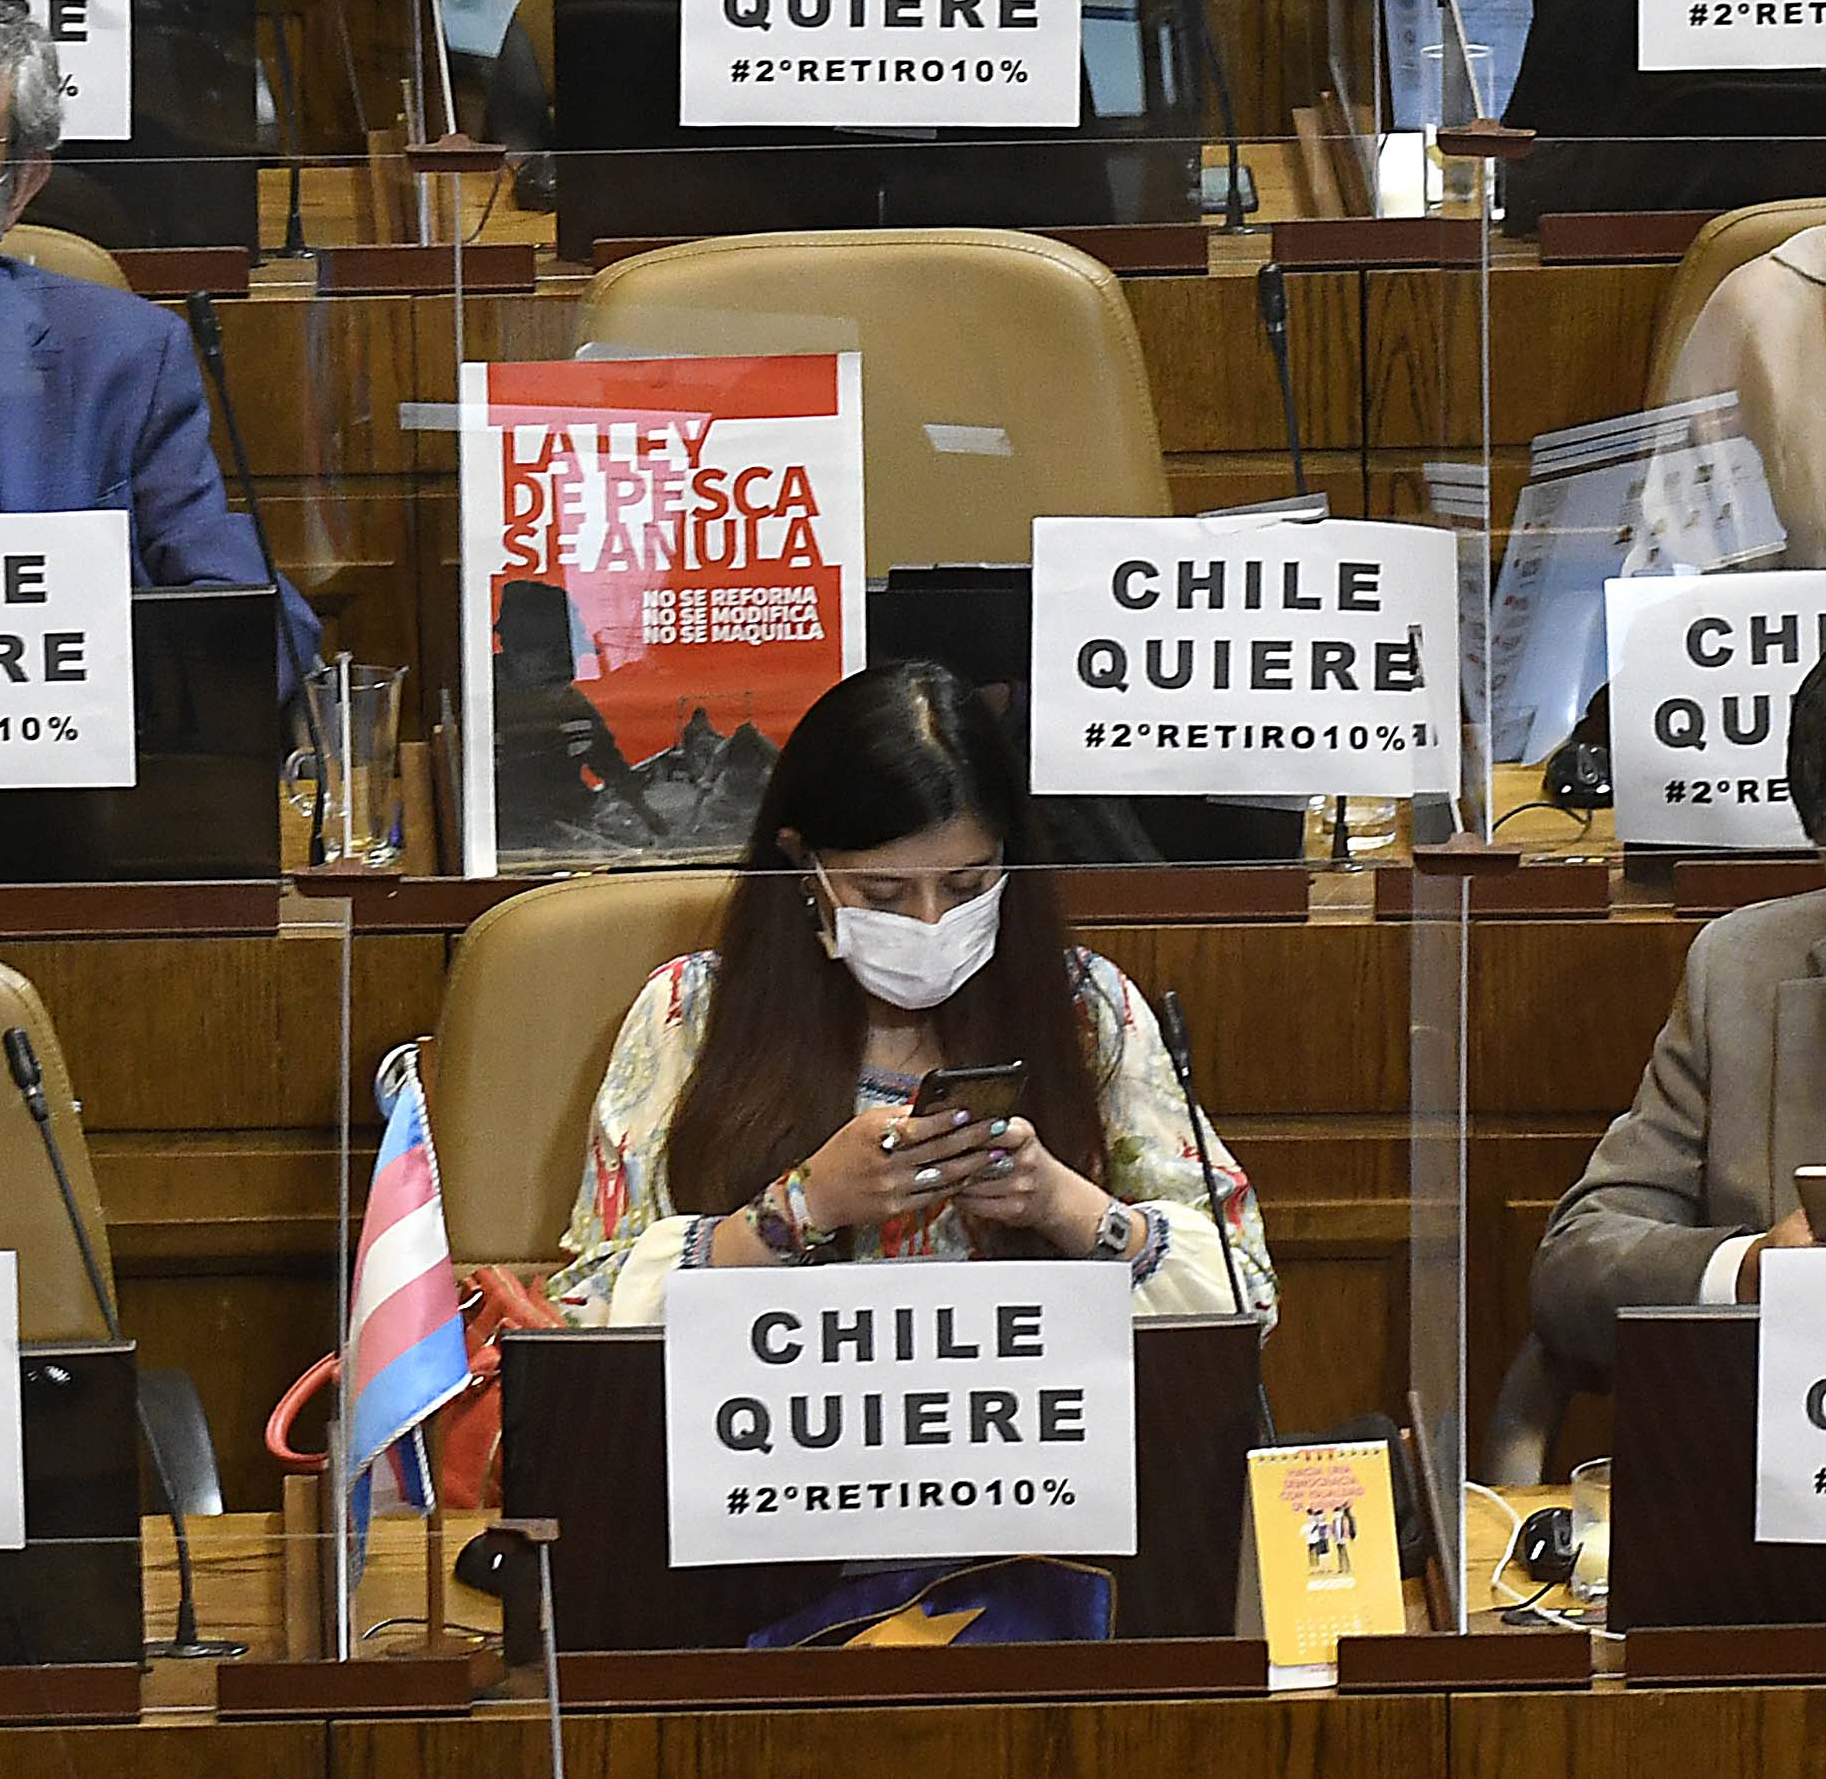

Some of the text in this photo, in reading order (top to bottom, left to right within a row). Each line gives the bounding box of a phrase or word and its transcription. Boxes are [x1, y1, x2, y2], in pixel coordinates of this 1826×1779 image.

[503, 416, 712, 473] LA LEY
[503, 465, 821, 524] DE PESCA
[502, 518, 825, 573] SE ANULA
[644, 586, 818, 608] NO SE REFORMA
[1113, 561, 1380, 611] CHILE
[643, 605, 819, 626] NO SE MODIFICA
[643, 622, 825, 646] NO SE MAQUILLA
[1078, 640, 1414, 692] QUIERE
[752, 1306, 1043, 1364] CHILE
[717, 1389, 1085, 1454] QUIERE
